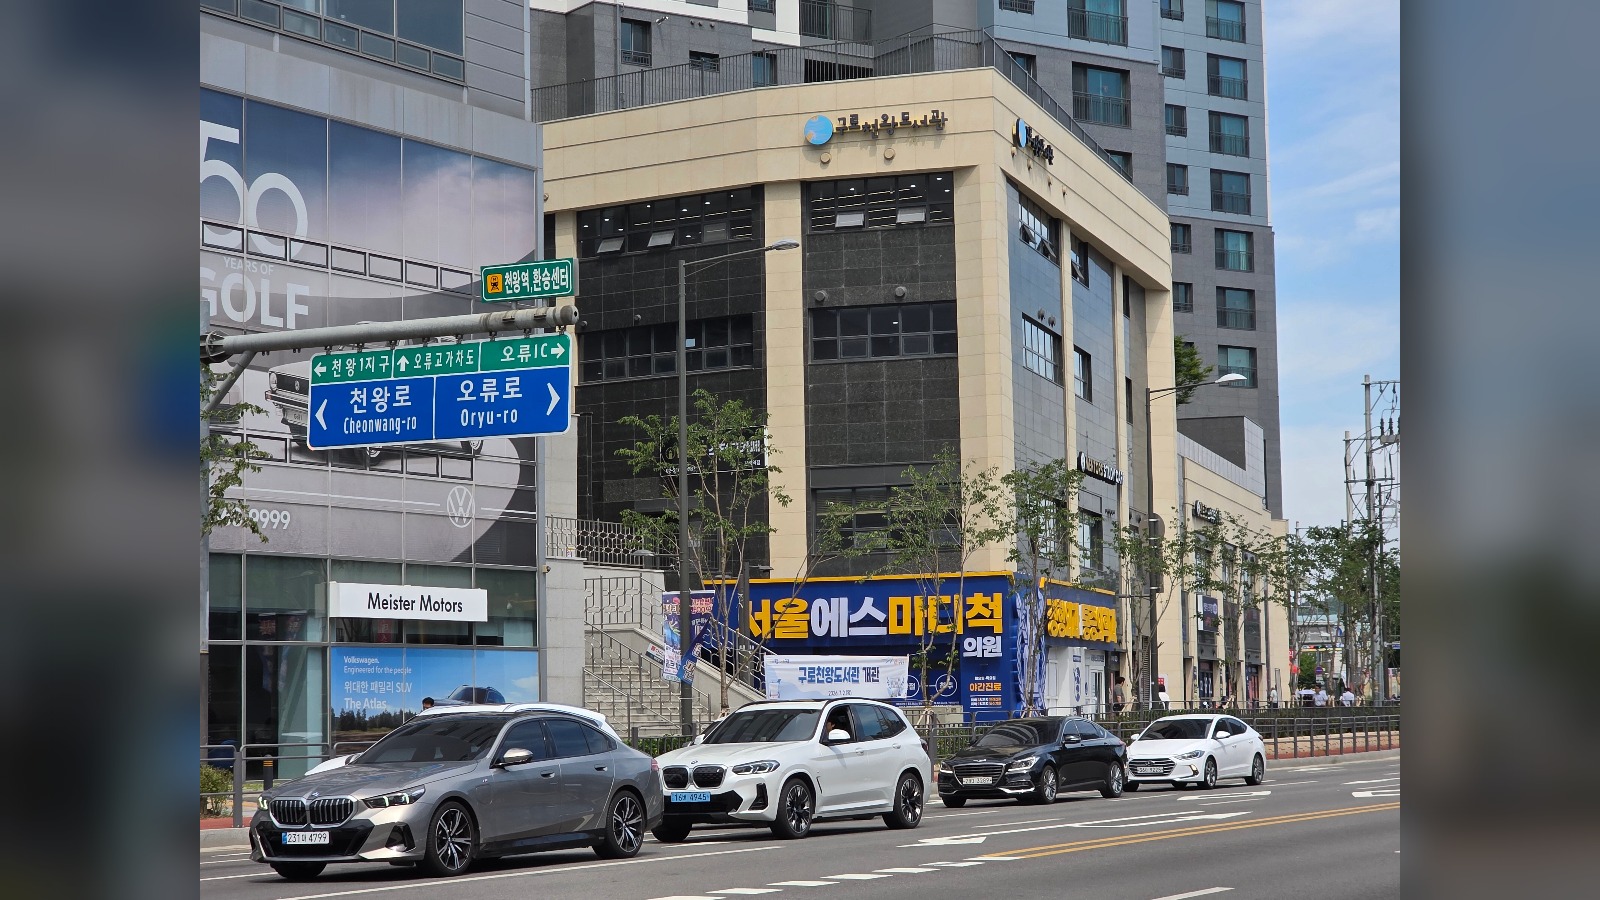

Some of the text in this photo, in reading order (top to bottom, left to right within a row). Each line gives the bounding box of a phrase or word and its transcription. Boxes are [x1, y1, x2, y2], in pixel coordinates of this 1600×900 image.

[836, 110, 948, 138] 구로천왕도서관
[223, 256, 274, 275] YEARS OF
[413, 349, 474, 371] 오류고가차도
[500, 343, 548, 363] 오류IC
[457, 376, 522, 402] 오류로
[349, 385, 412, 414] 천왕로
[343, 416, 417, 434] Cheonwang-ro
[460, 408, 518, 428] Oryu-ro
[367, 592, 463, 612] Meister Motors
[962, 636, 1003, 658] 의원
[344, 666, 374, 675] Engineered
[375, 666, 383, 674] for
[384, 666, 393, 674] the
[798, 666, 880, 684] 구로천왕도서관 개관
[344, 681, 369, 693] 위대한
[370, 681, 394, 694] 패밀리
[344, 698, 387, 710] The Atlas
